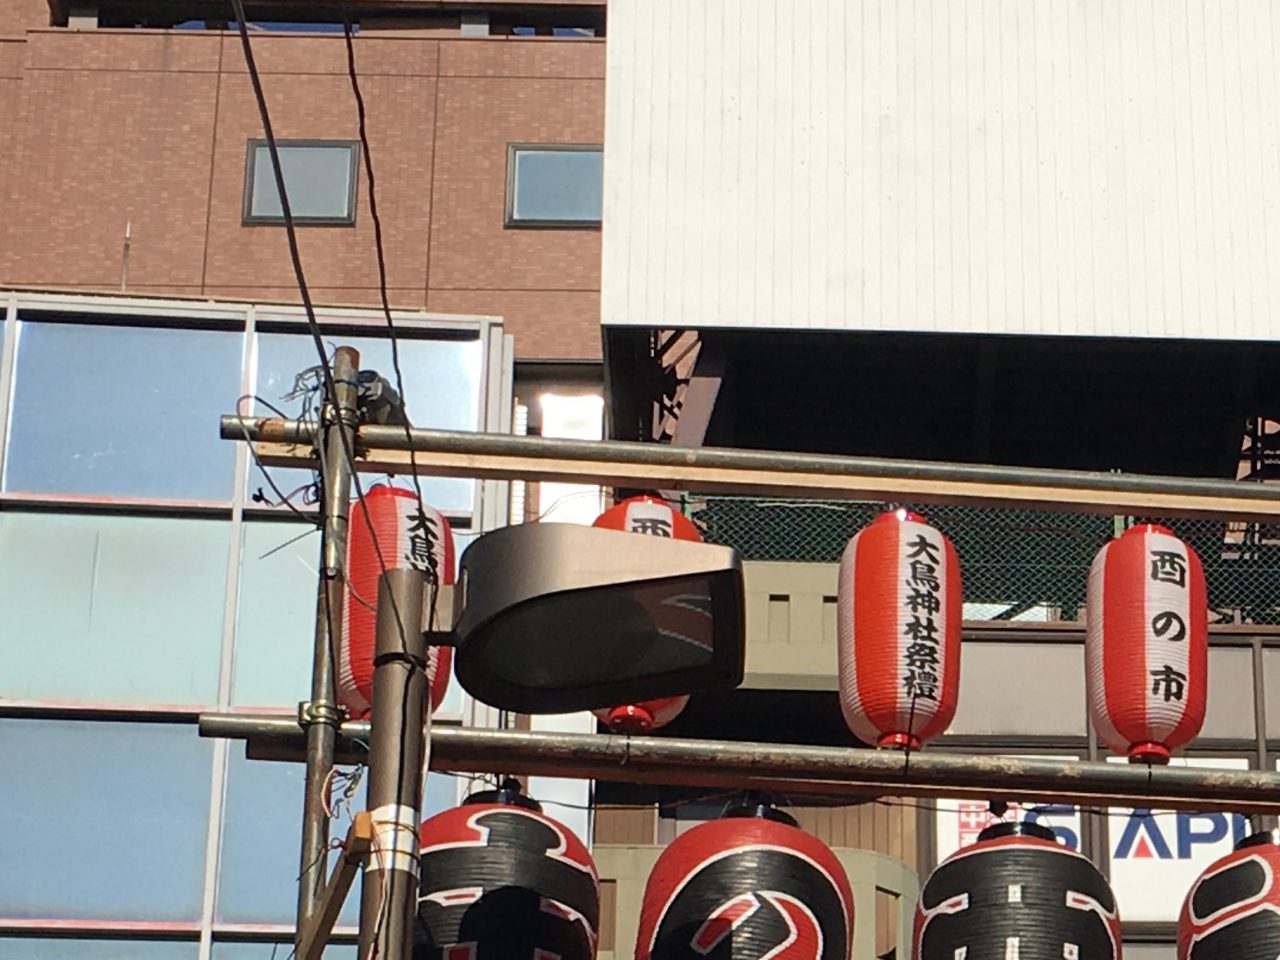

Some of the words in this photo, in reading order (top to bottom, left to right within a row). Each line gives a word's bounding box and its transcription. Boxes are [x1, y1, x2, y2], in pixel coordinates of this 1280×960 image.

[903, 532, 941, 701] 大鳥神社祭禮
[1150, 549, 1187, 703] 酉の市
